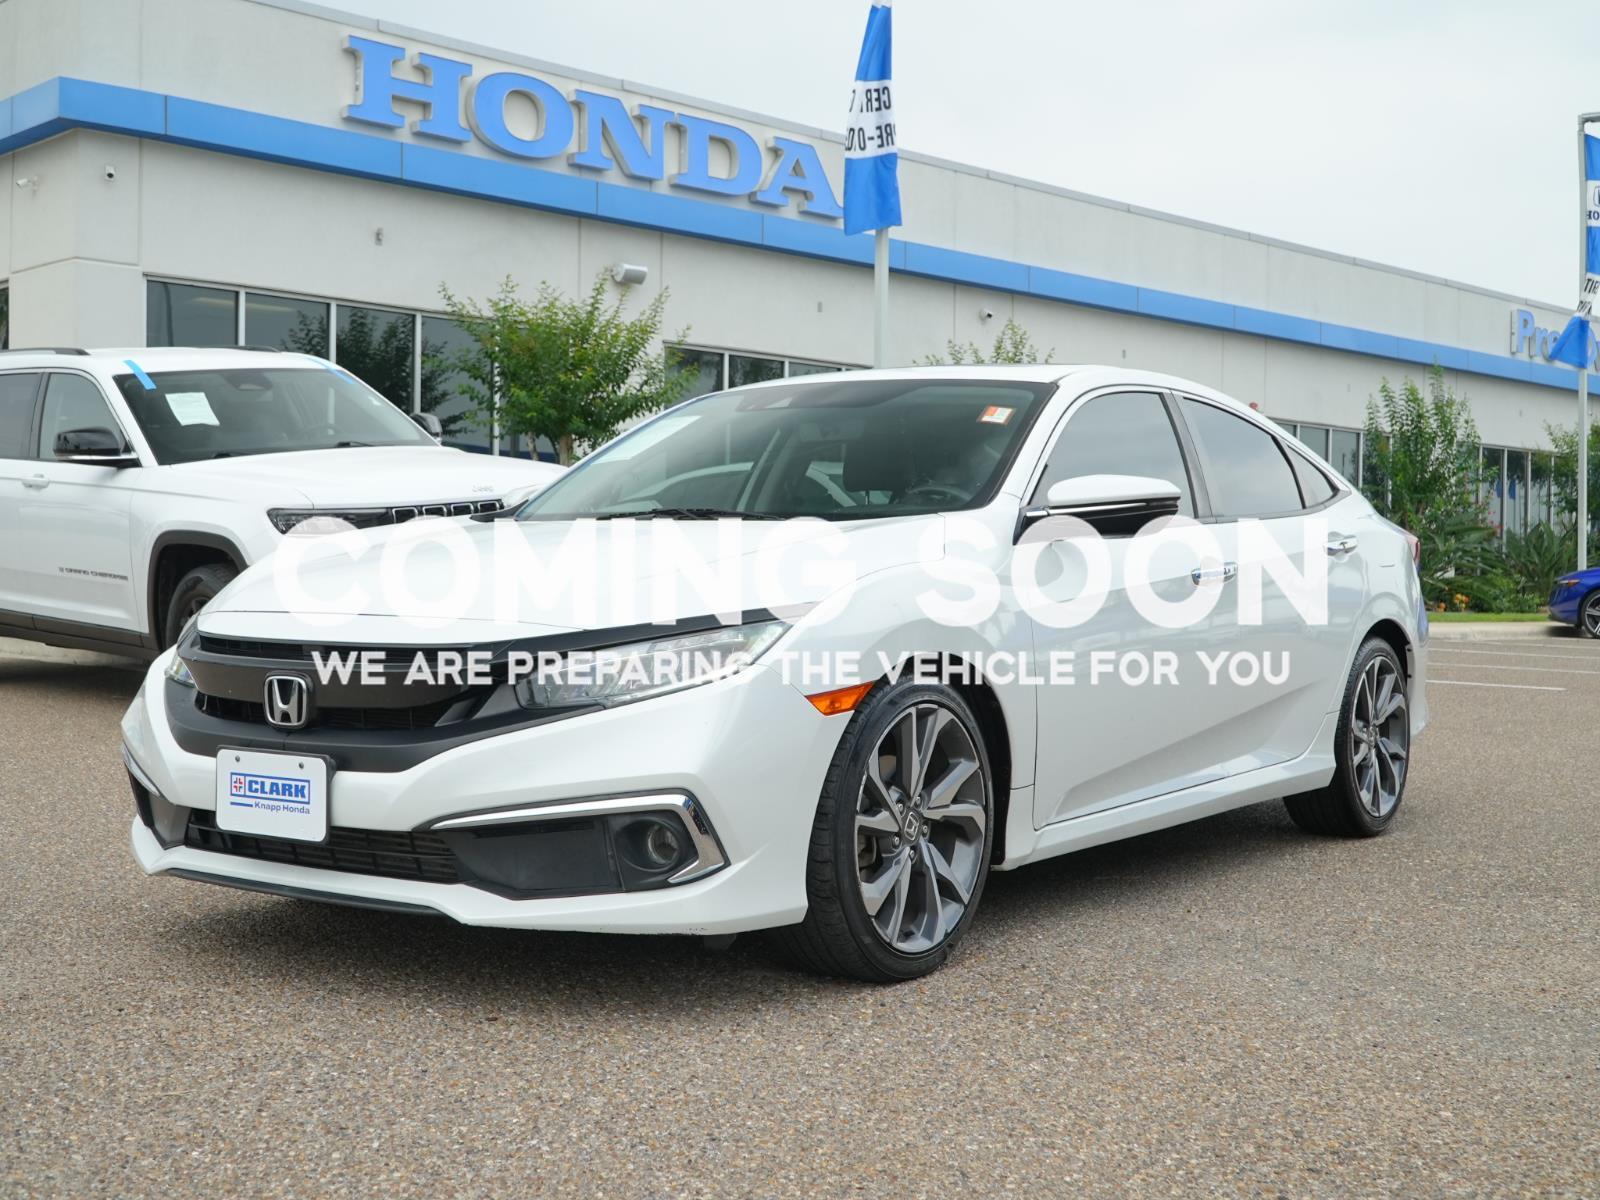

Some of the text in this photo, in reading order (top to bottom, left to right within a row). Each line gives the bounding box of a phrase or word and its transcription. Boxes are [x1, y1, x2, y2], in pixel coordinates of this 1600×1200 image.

[341, 34, 843, 219] HONDA
[248, 779, 306, 798] CLARK
[254, 801, 311, 814] Knapp Honda
